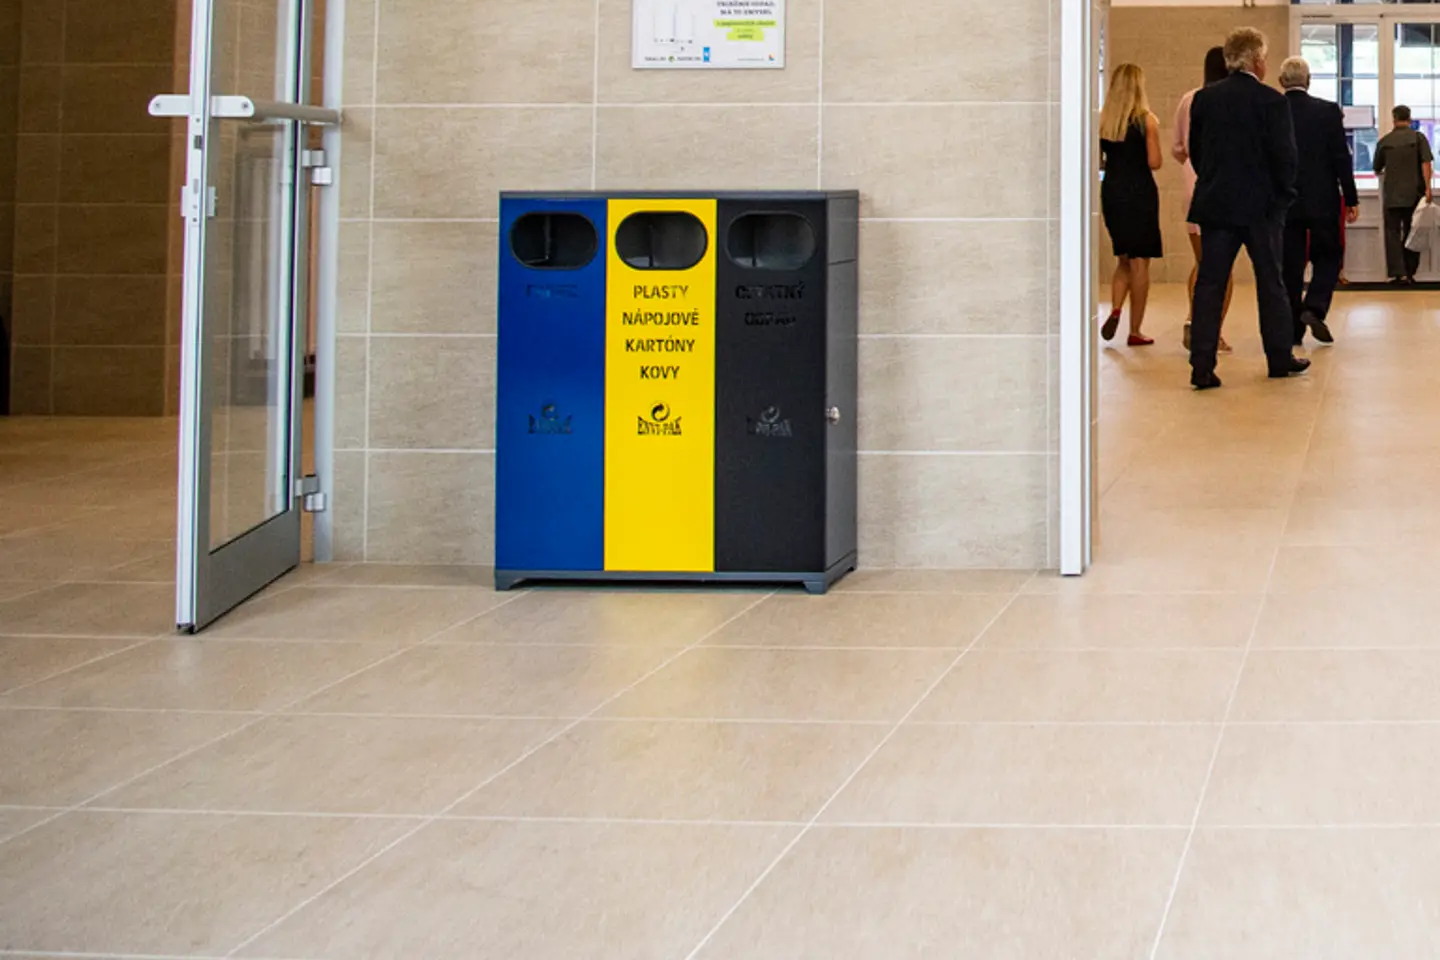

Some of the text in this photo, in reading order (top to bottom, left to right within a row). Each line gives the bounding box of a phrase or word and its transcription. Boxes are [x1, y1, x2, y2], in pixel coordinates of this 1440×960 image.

[633, 285, 689, 299] PLASTY
[622, 308, 700, 326] NÁPOJOVÉ
[625, 335, 696, 352] KARTÓNY
[639, 365, 681, 379] KOVY
